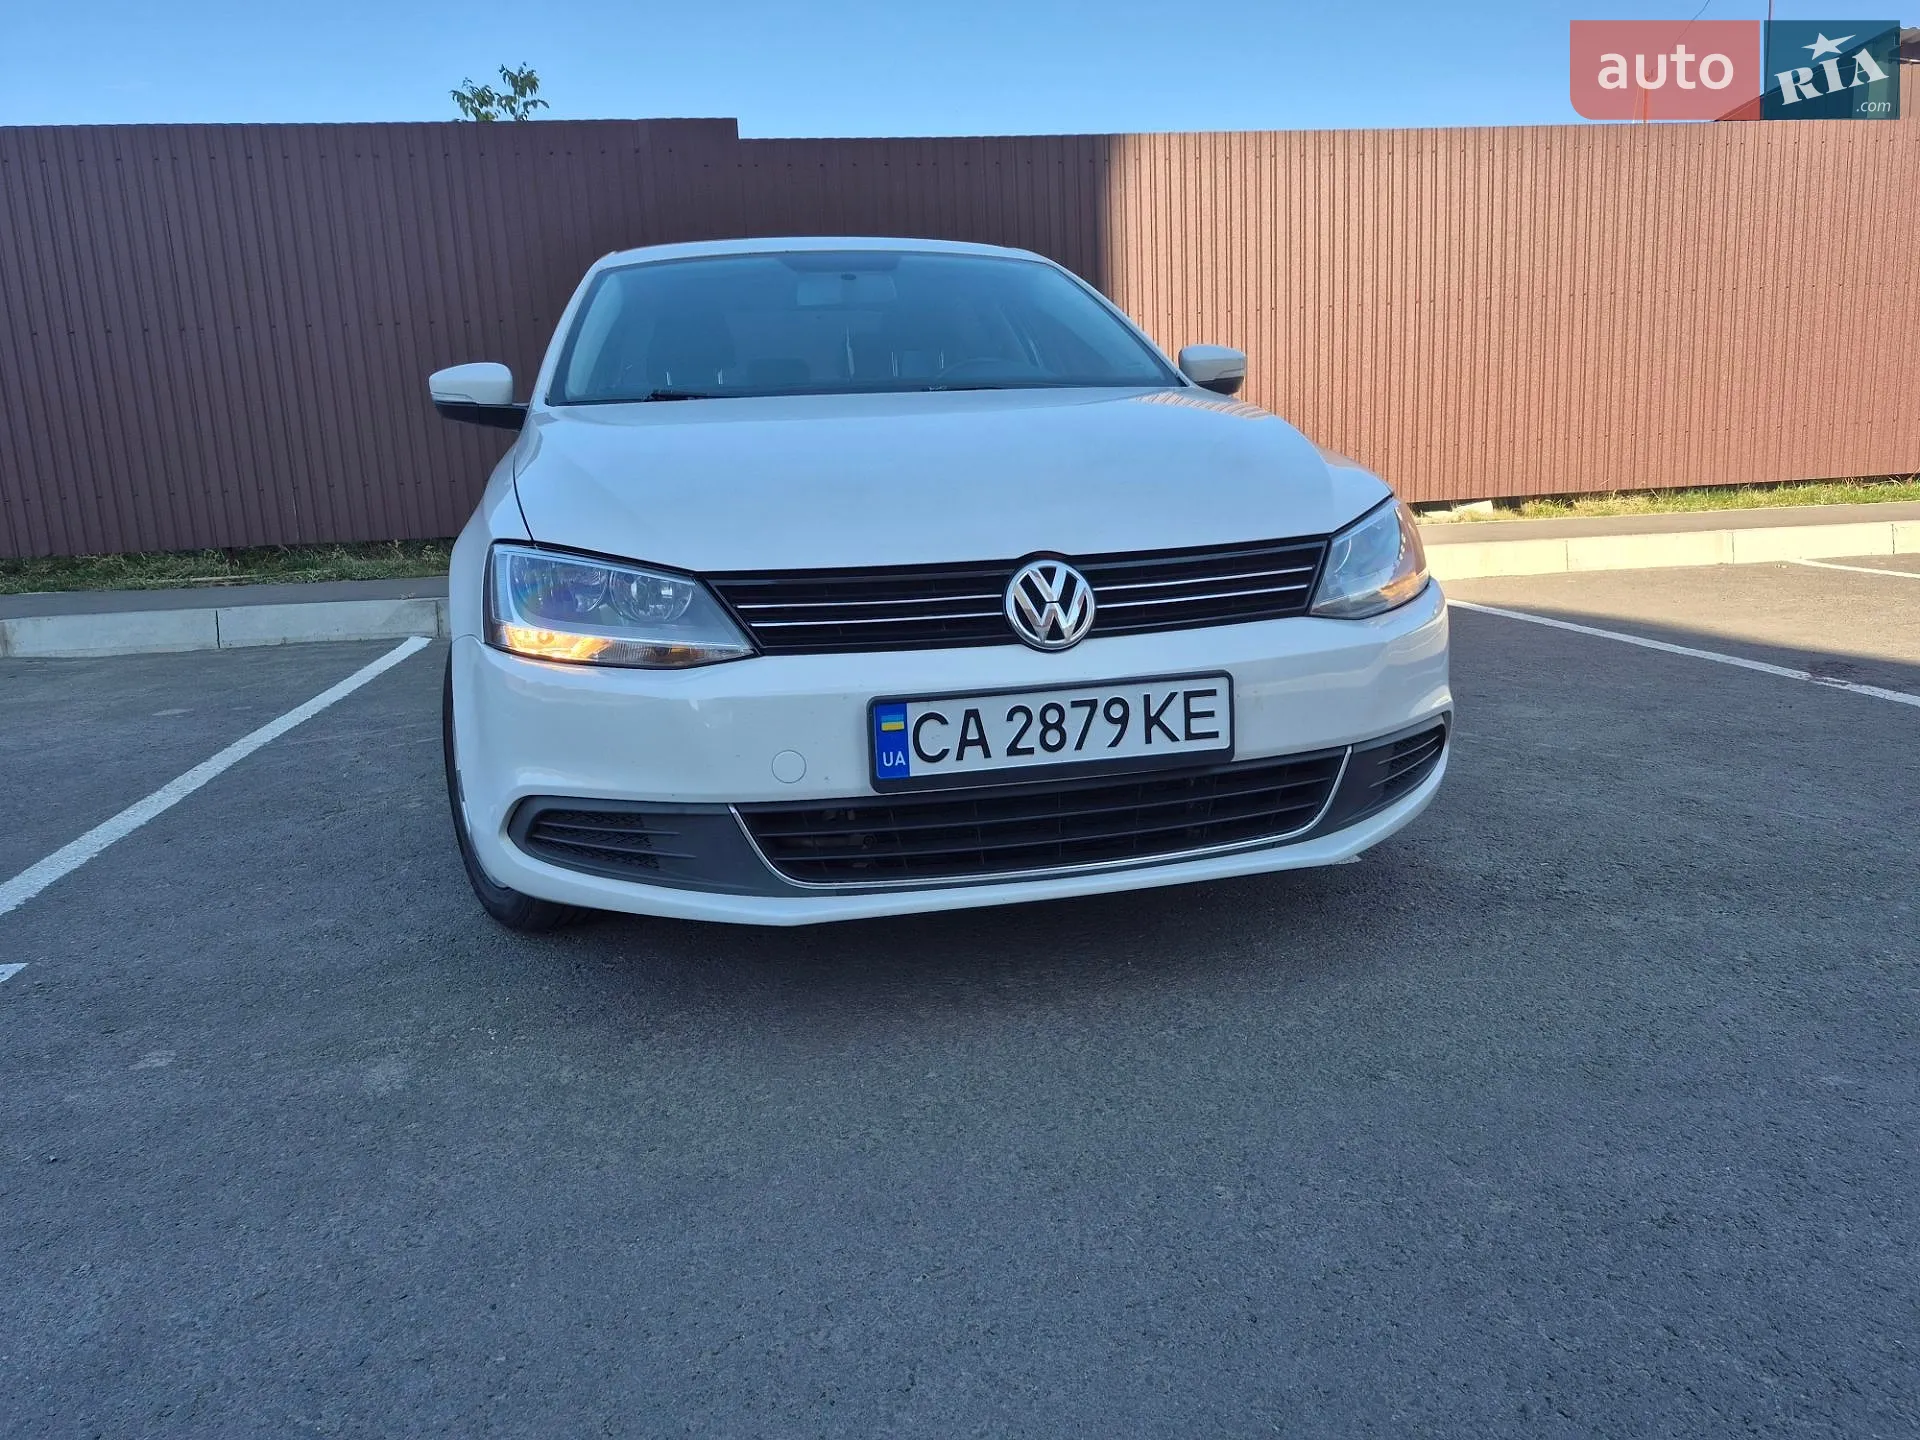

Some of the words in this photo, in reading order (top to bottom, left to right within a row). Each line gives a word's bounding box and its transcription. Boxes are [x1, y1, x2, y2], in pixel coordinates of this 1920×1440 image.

[1006, 560, 1094, 649] VW
[883, 751, 906, 768] UA
[912, 708, 992, 763] CA
[1006, 697, 1130, 757] 2879
[1143, 689, 1220, 745] KE
